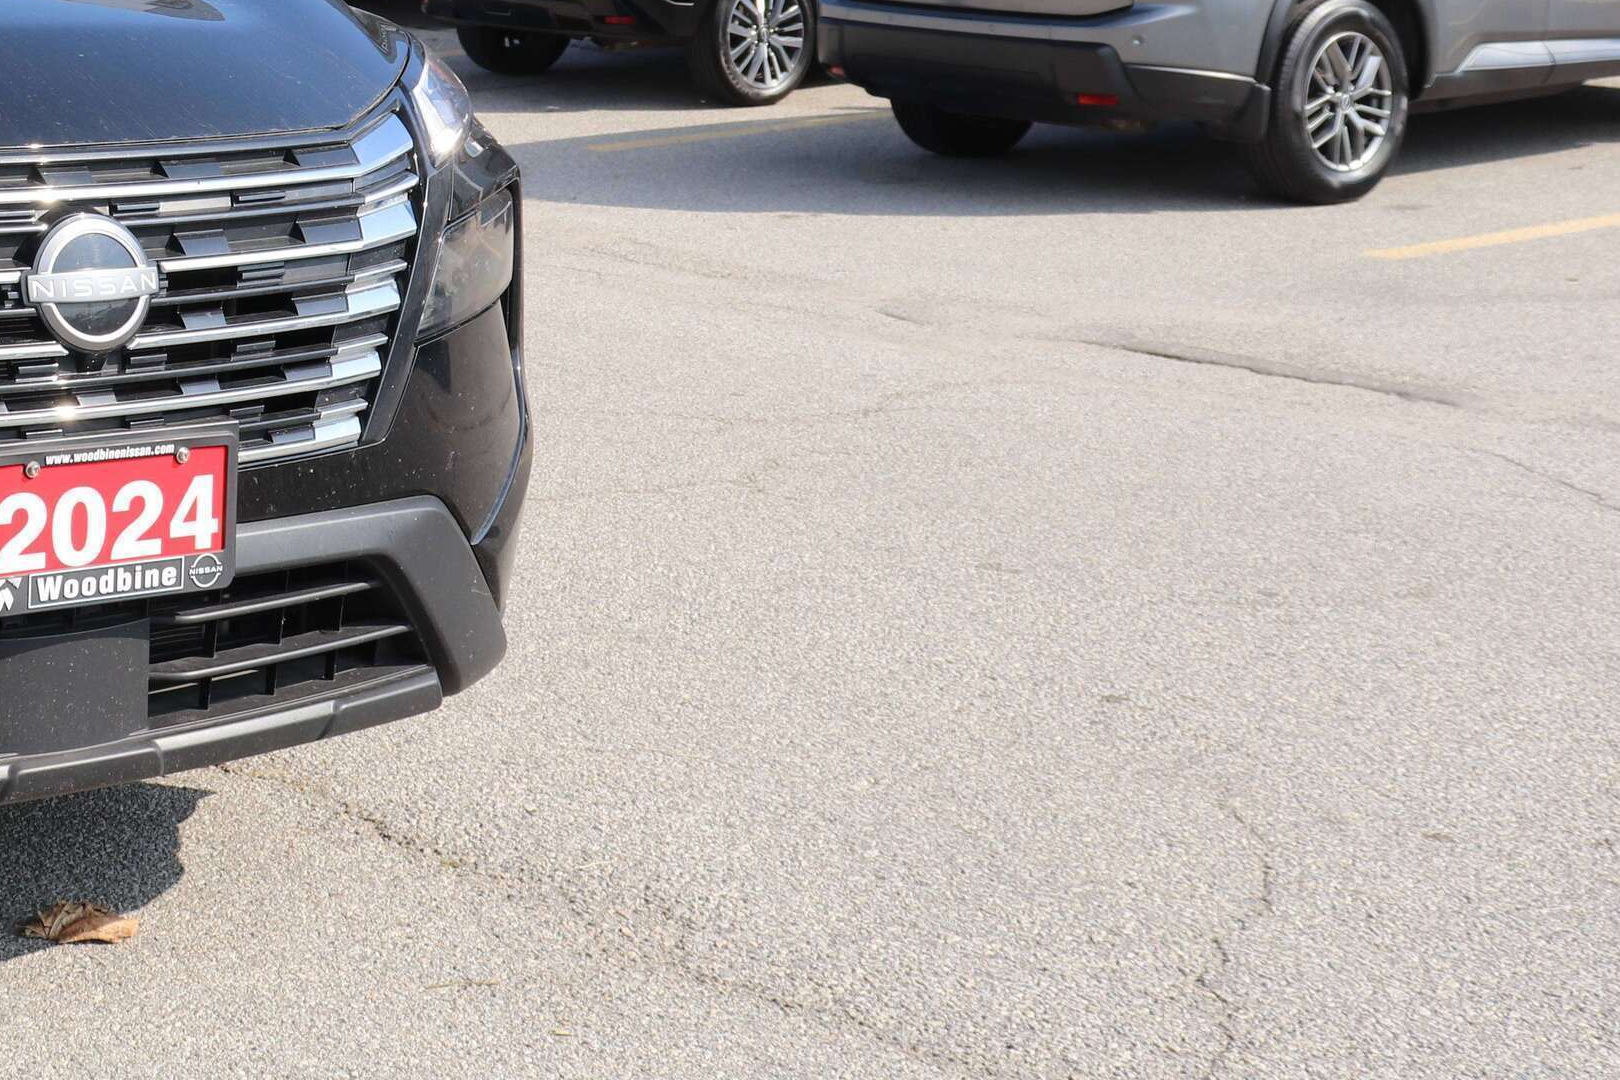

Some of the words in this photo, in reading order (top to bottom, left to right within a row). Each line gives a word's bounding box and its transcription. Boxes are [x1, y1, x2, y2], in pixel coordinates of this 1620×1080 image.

[32, 271, 157, 298] NISSAN
[45, 443, 176, 466] www.woodbinenissan.com
[188, 564, 224, 576] NISSAN
[36, 564, 178, 602] Woodbine
